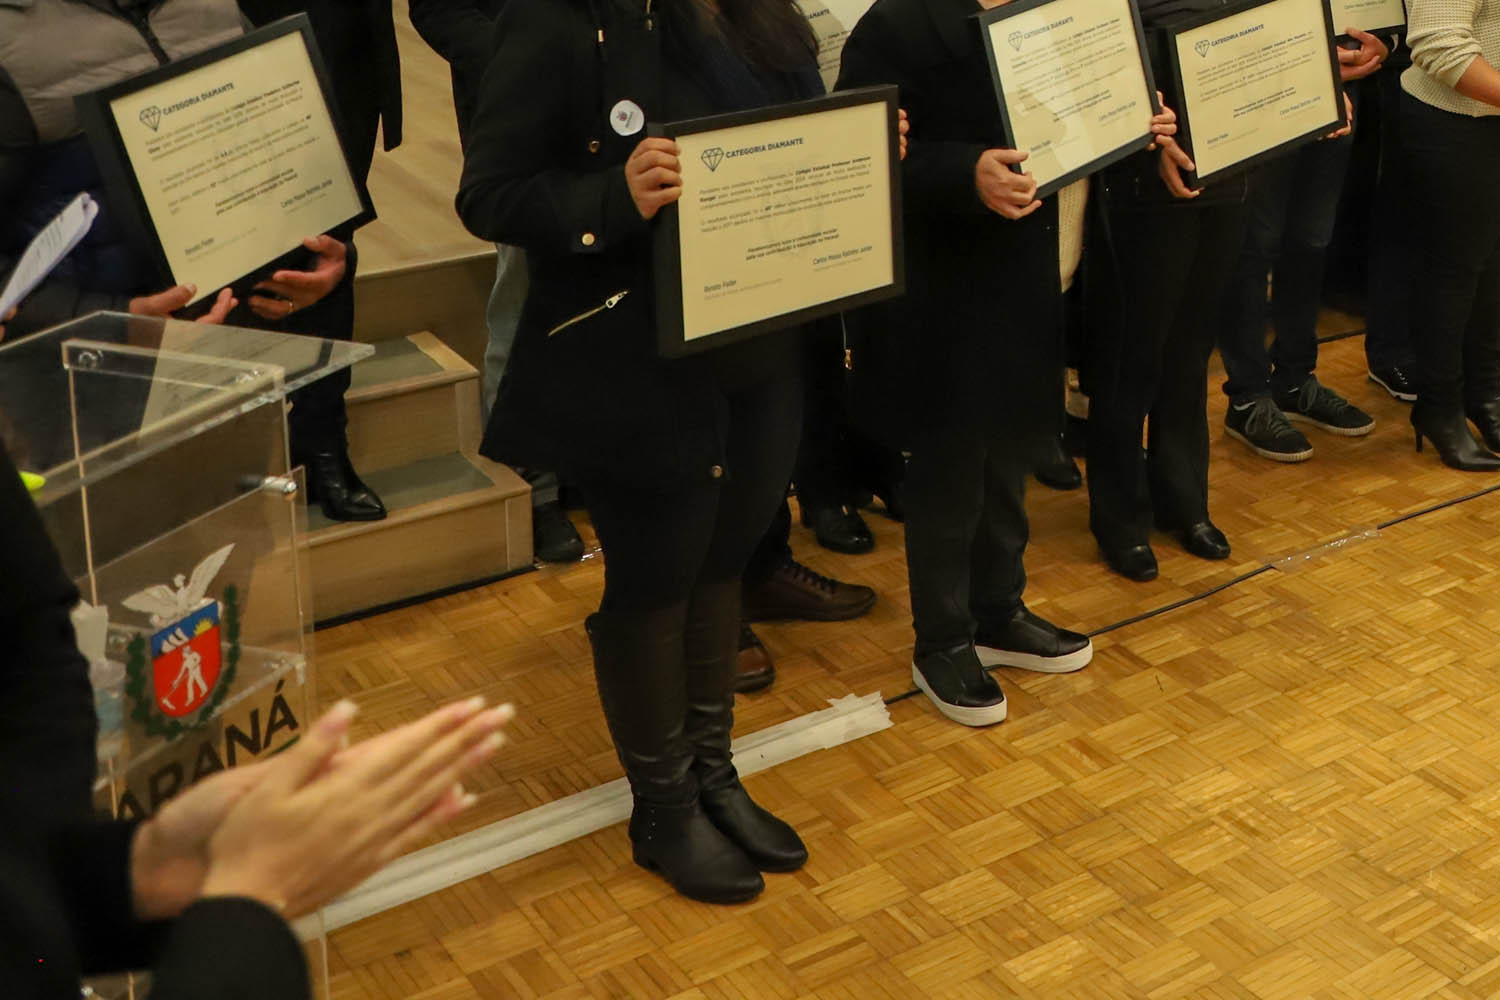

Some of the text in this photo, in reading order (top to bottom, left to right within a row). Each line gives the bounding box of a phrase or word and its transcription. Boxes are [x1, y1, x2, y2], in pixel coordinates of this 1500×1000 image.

[726, 137, 804, 159] CATEGORIA DIAMANTE
[118, 679, 300, 820] ARANÁ
